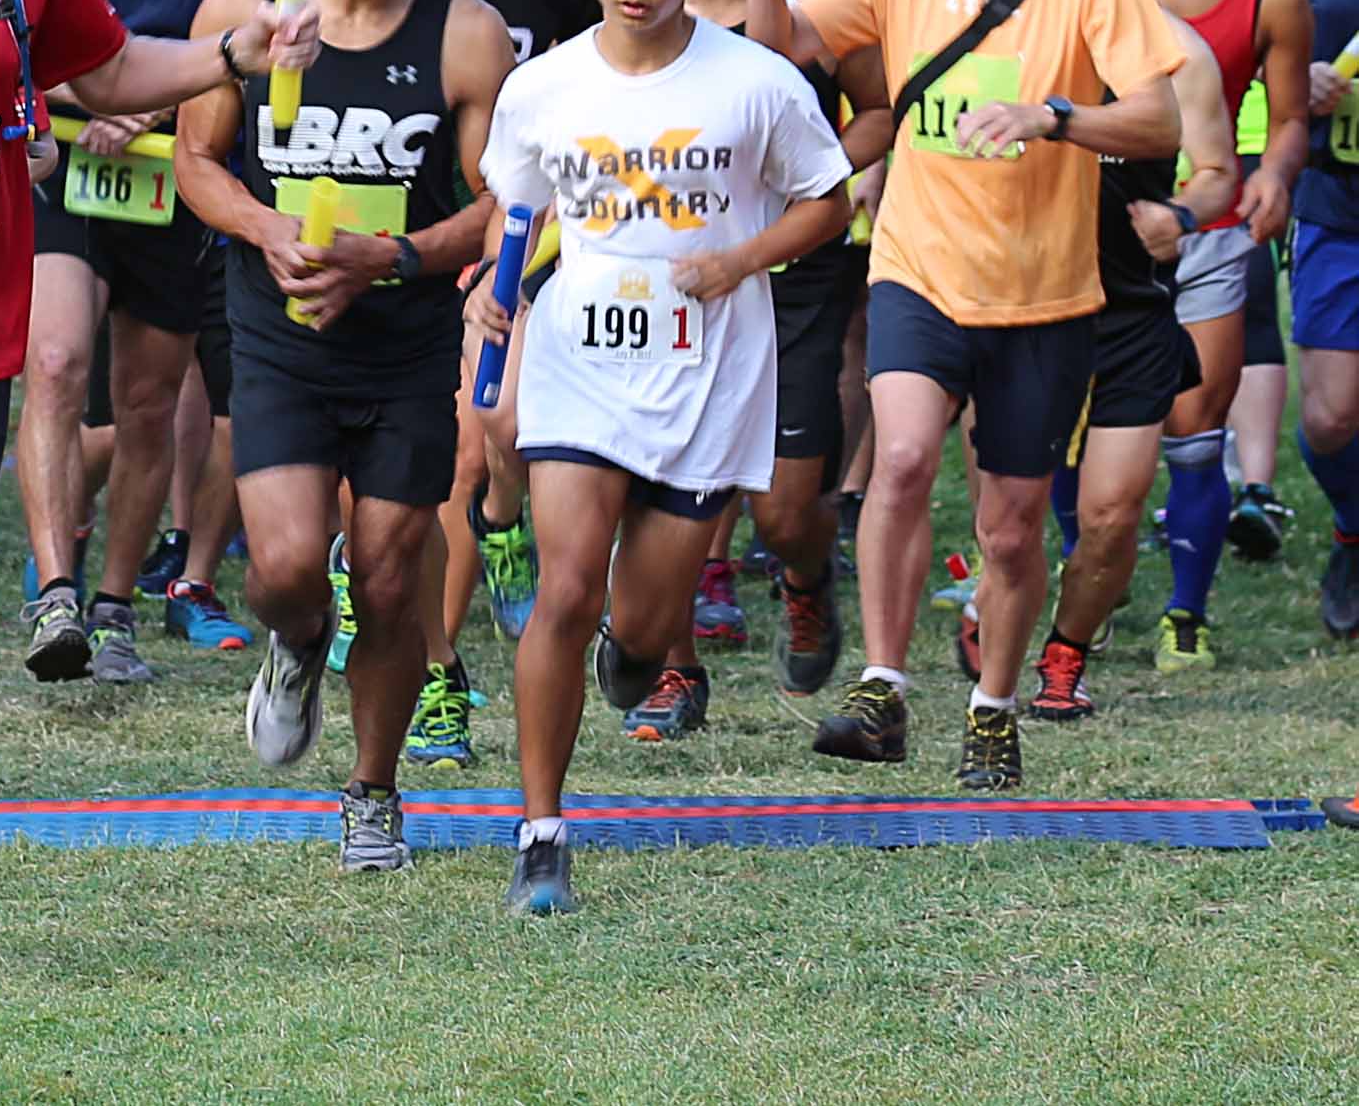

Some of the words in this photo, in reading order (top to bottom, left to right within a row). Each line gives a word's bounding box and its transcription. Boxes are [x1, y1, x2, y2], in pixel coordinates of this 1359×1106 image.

[257, 105, 442, 168] LBRC
[74, 161, 133, 204] 166
[149, 171, 166, 212] 1
[581, 301, 649, 350] 199
[672, 304, 692, 350] 1
